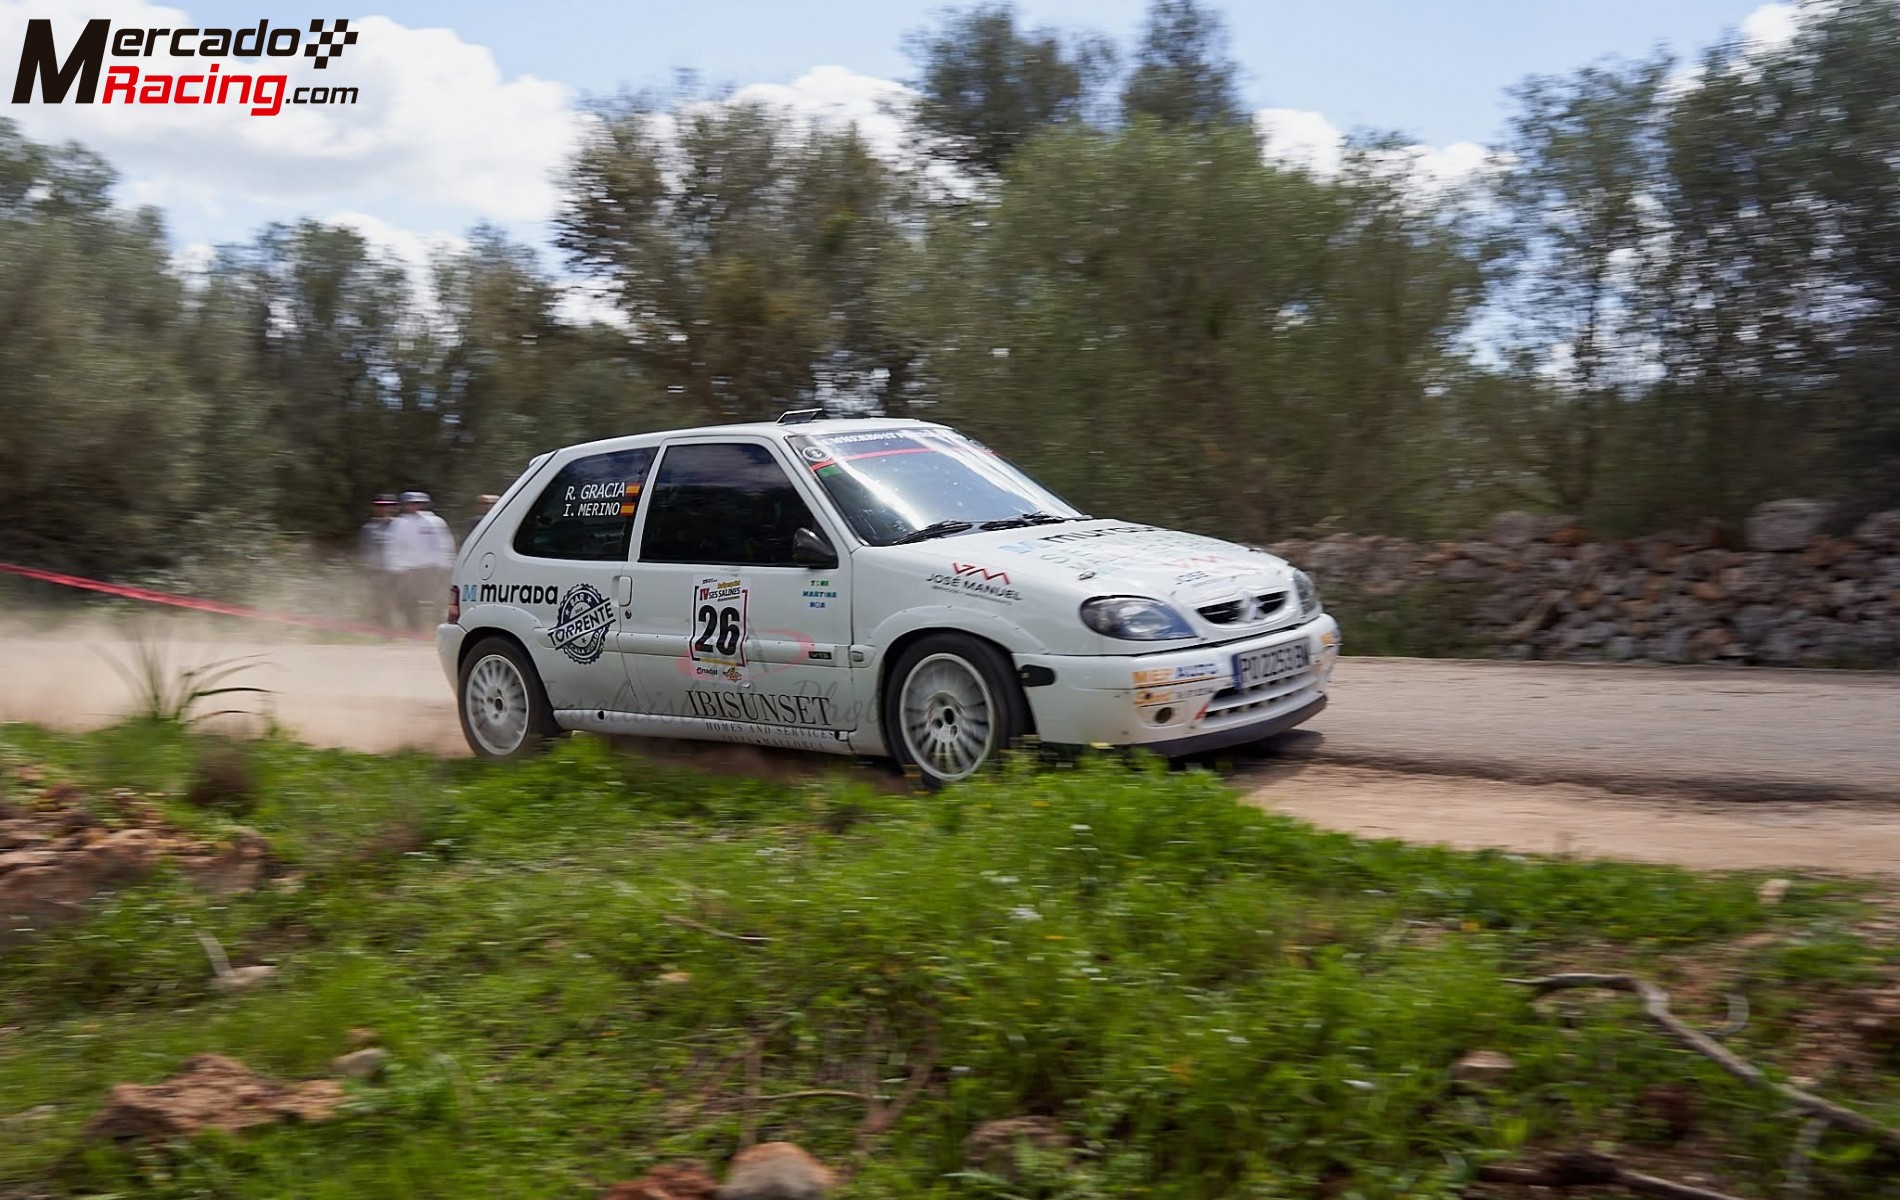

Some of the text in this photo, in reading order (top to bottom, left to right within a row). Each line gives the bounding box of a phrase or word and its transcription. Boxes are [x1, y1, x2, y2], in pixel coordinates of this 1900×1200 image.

[565, 482, 625, 501] R. GRACIA
[563, 502, 620, 517] I. MERINO
[718, 587, 741, 598] SALINES
[962, 580, 1023, 600] MANUEL
[570, 593, 585, 607] BAR
[547, 601, 614, 646] TORRENTE
[695, 604, 740, 656] 26
[685, 690, 832, 726] IBISUNSET
[706, 722, 835, 740] HOMES AND SERVICES
